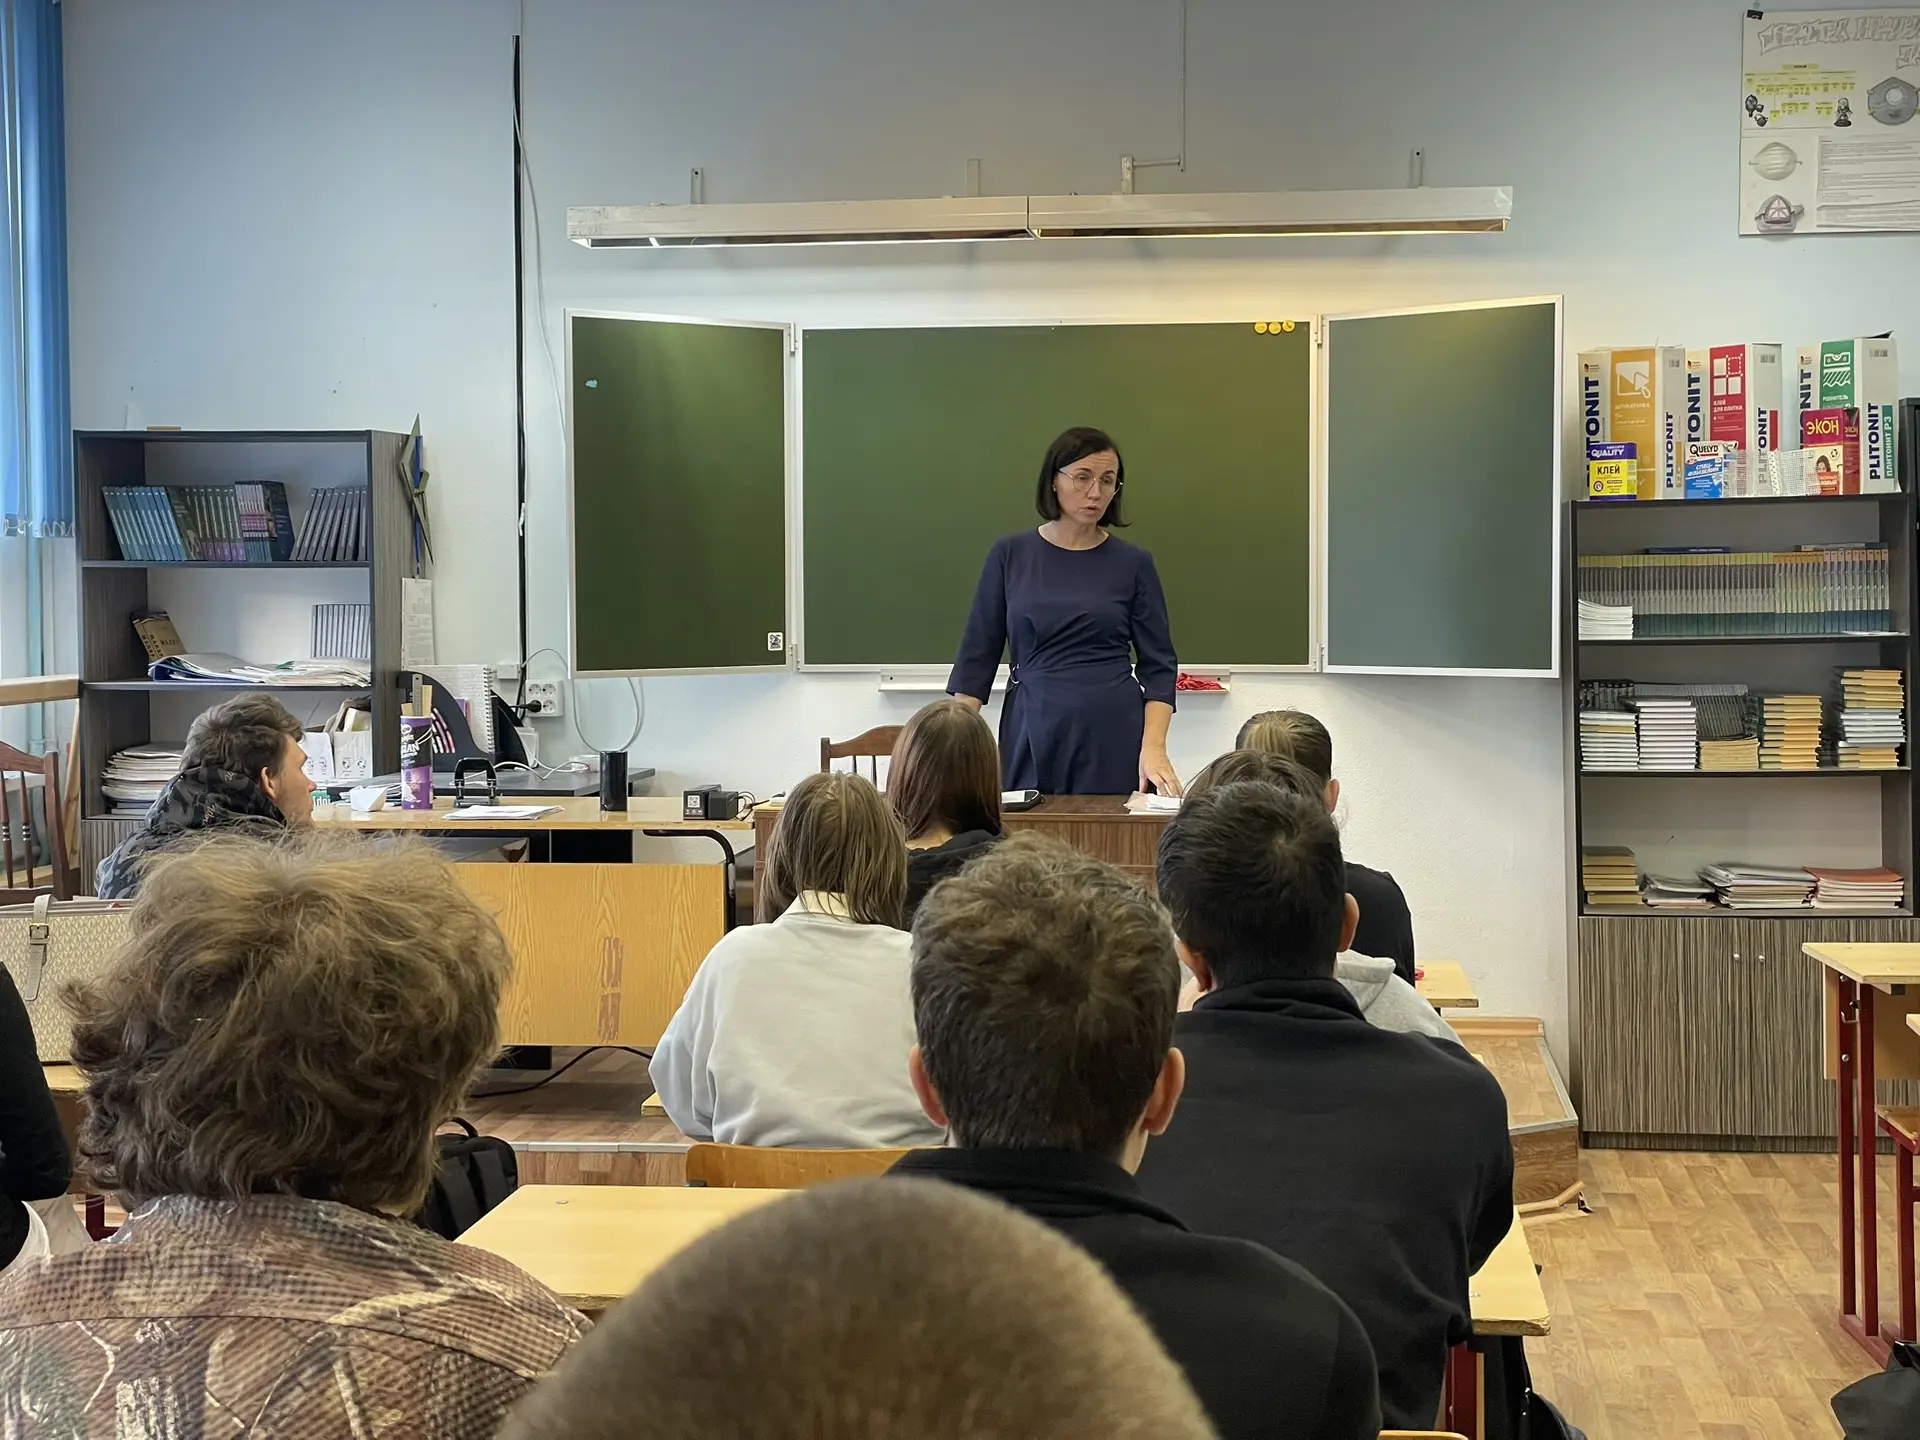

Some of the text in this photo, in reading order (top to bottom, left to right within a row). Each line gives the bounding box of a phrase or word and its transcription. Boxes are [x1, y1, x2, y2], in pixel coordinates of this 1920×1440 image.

[1687, 373, 1700, 442] TONIT
[1806, 419, 1839, 436] ЭКОН
[1591, 449, 1625, 458] QUALITY
[1665, 412, 1674, 488] PLITONIT
[1867, 403, 1880, 480] PLITONIT
[1883, 433, 1894, 477] ПЛИТОНИТ
[1597, 464, 1620, 475] КЛЕЙ
